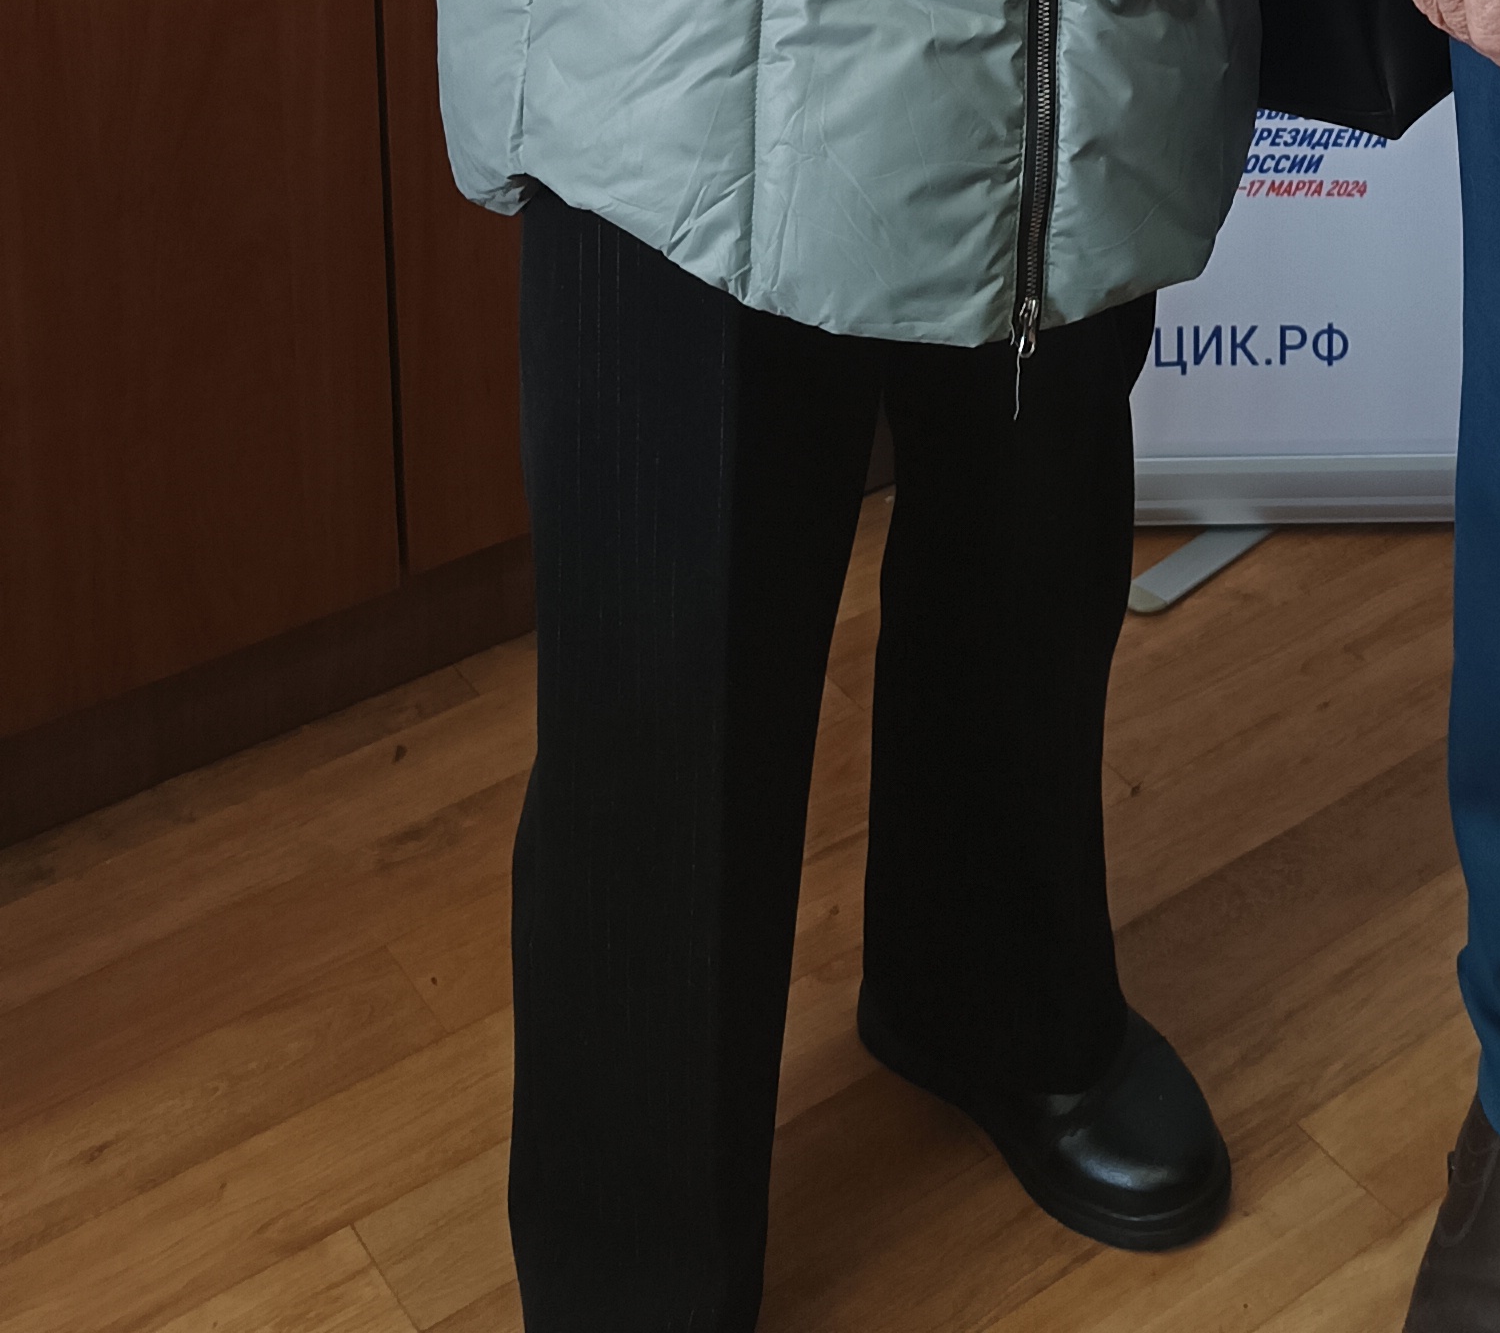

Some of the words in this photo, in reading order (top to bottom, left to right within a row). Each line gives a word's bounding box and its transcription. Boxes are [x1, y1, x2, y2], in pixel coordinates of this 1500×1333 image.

[1254, 128, 1388, 150] РЕЗИДЕНТА
[1243, 154, 1324, 174] ОССИИ
[1265, 180, 1324, 197] МАРТА
[1325, 180, 1367, 198] 2024
[1154, 322, 1349, 375] ЦИК.РФ
